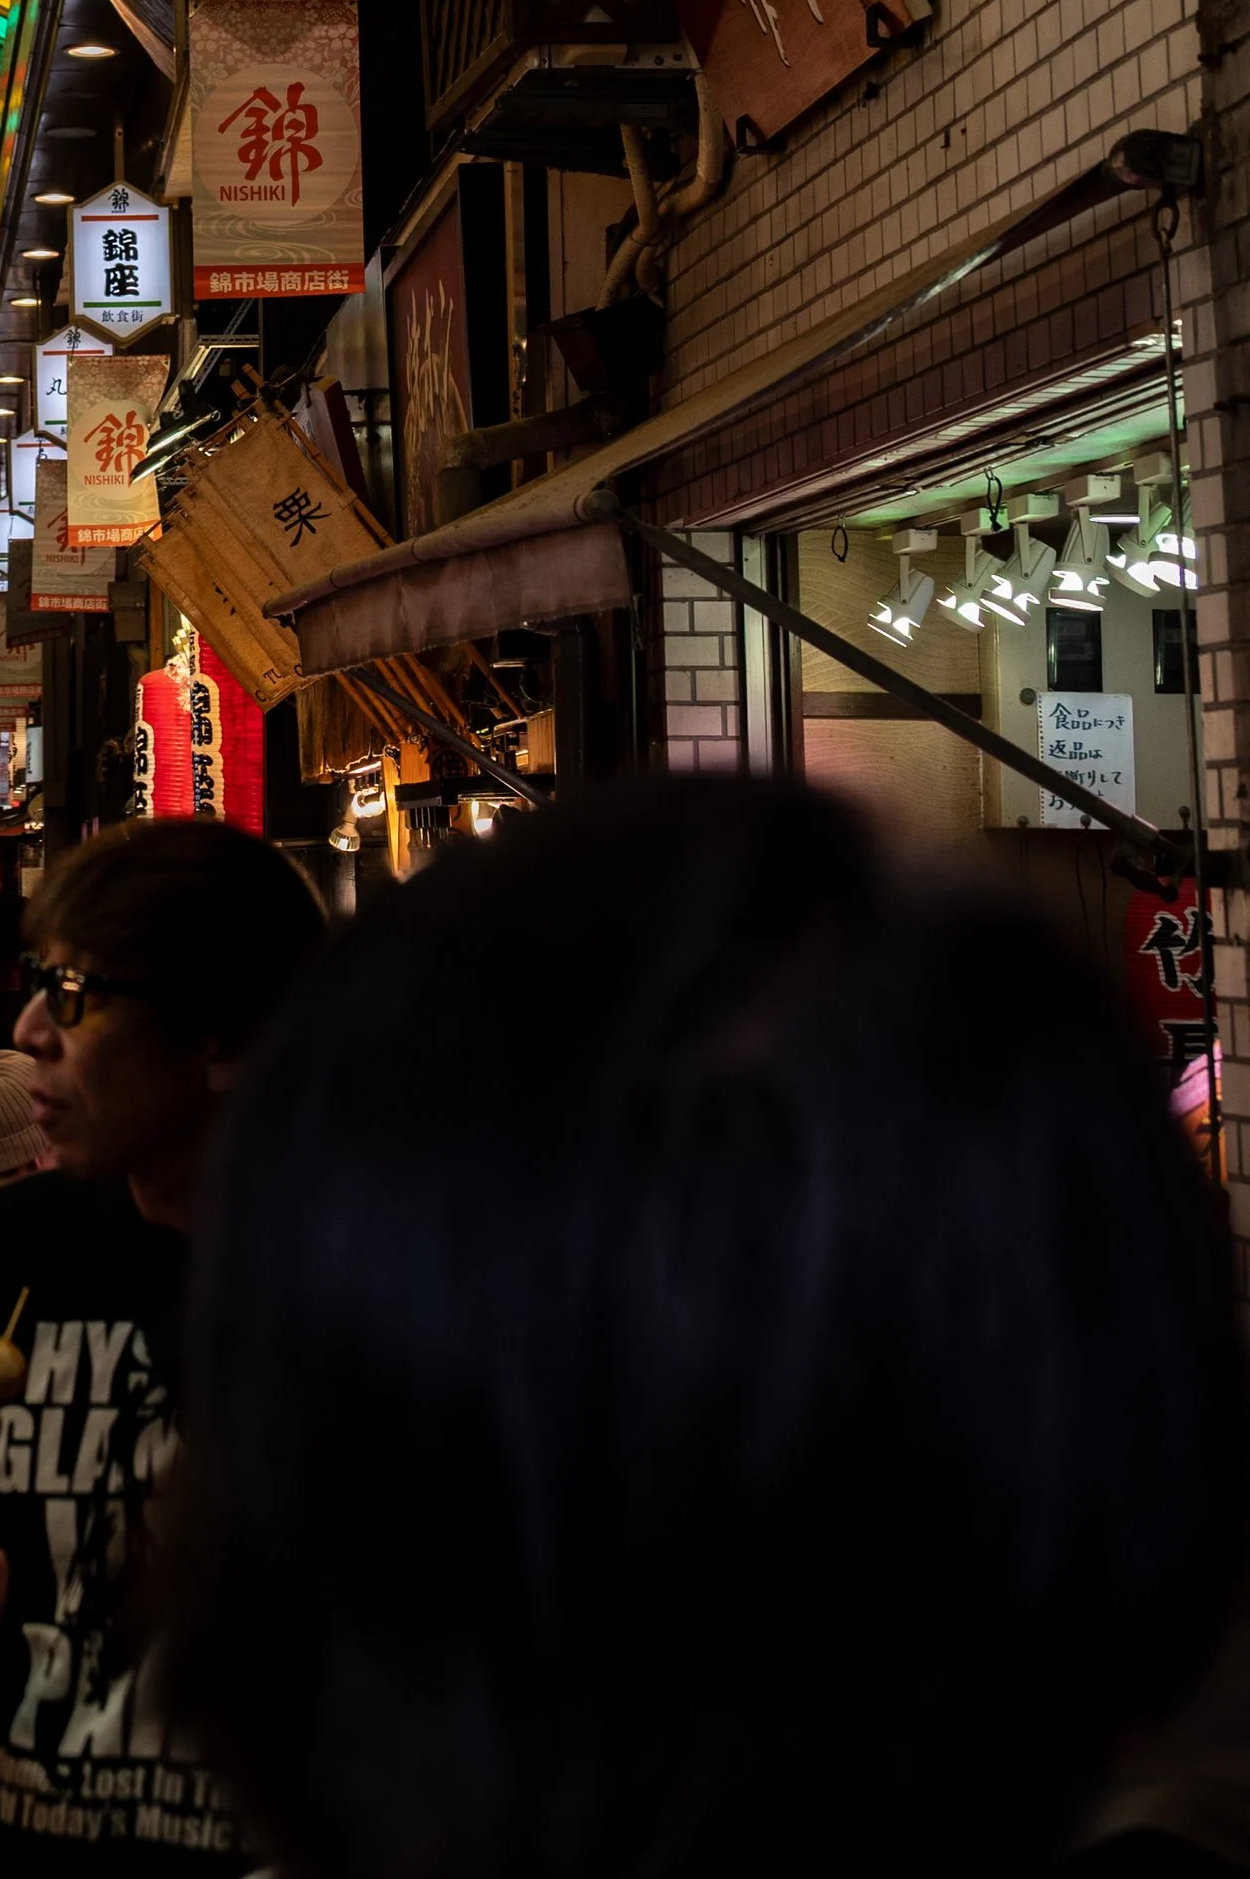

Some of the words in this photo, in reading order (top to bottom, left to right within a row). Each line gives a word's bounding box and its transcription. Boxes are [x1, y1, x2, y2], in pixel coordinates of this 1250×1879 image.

[217, 81, 324, 208] 錦
[107, 188, 130, 213] 錦
[219, 184, 286, 202] NISHIKI
[101, 228, 140, 298] 錦座
[209, 269, 350, 294] 錦市場商店街
[101, 309, 144, 323] 飲食街
[83, 409, 148, 489] 錦
[83, 474, 125, 486] NISHIKI
[273, 487, 333, 547] 栗
[1048, 702, 1126, 731] 食品につき
[1048, 739, 1103, 761] 返品は
